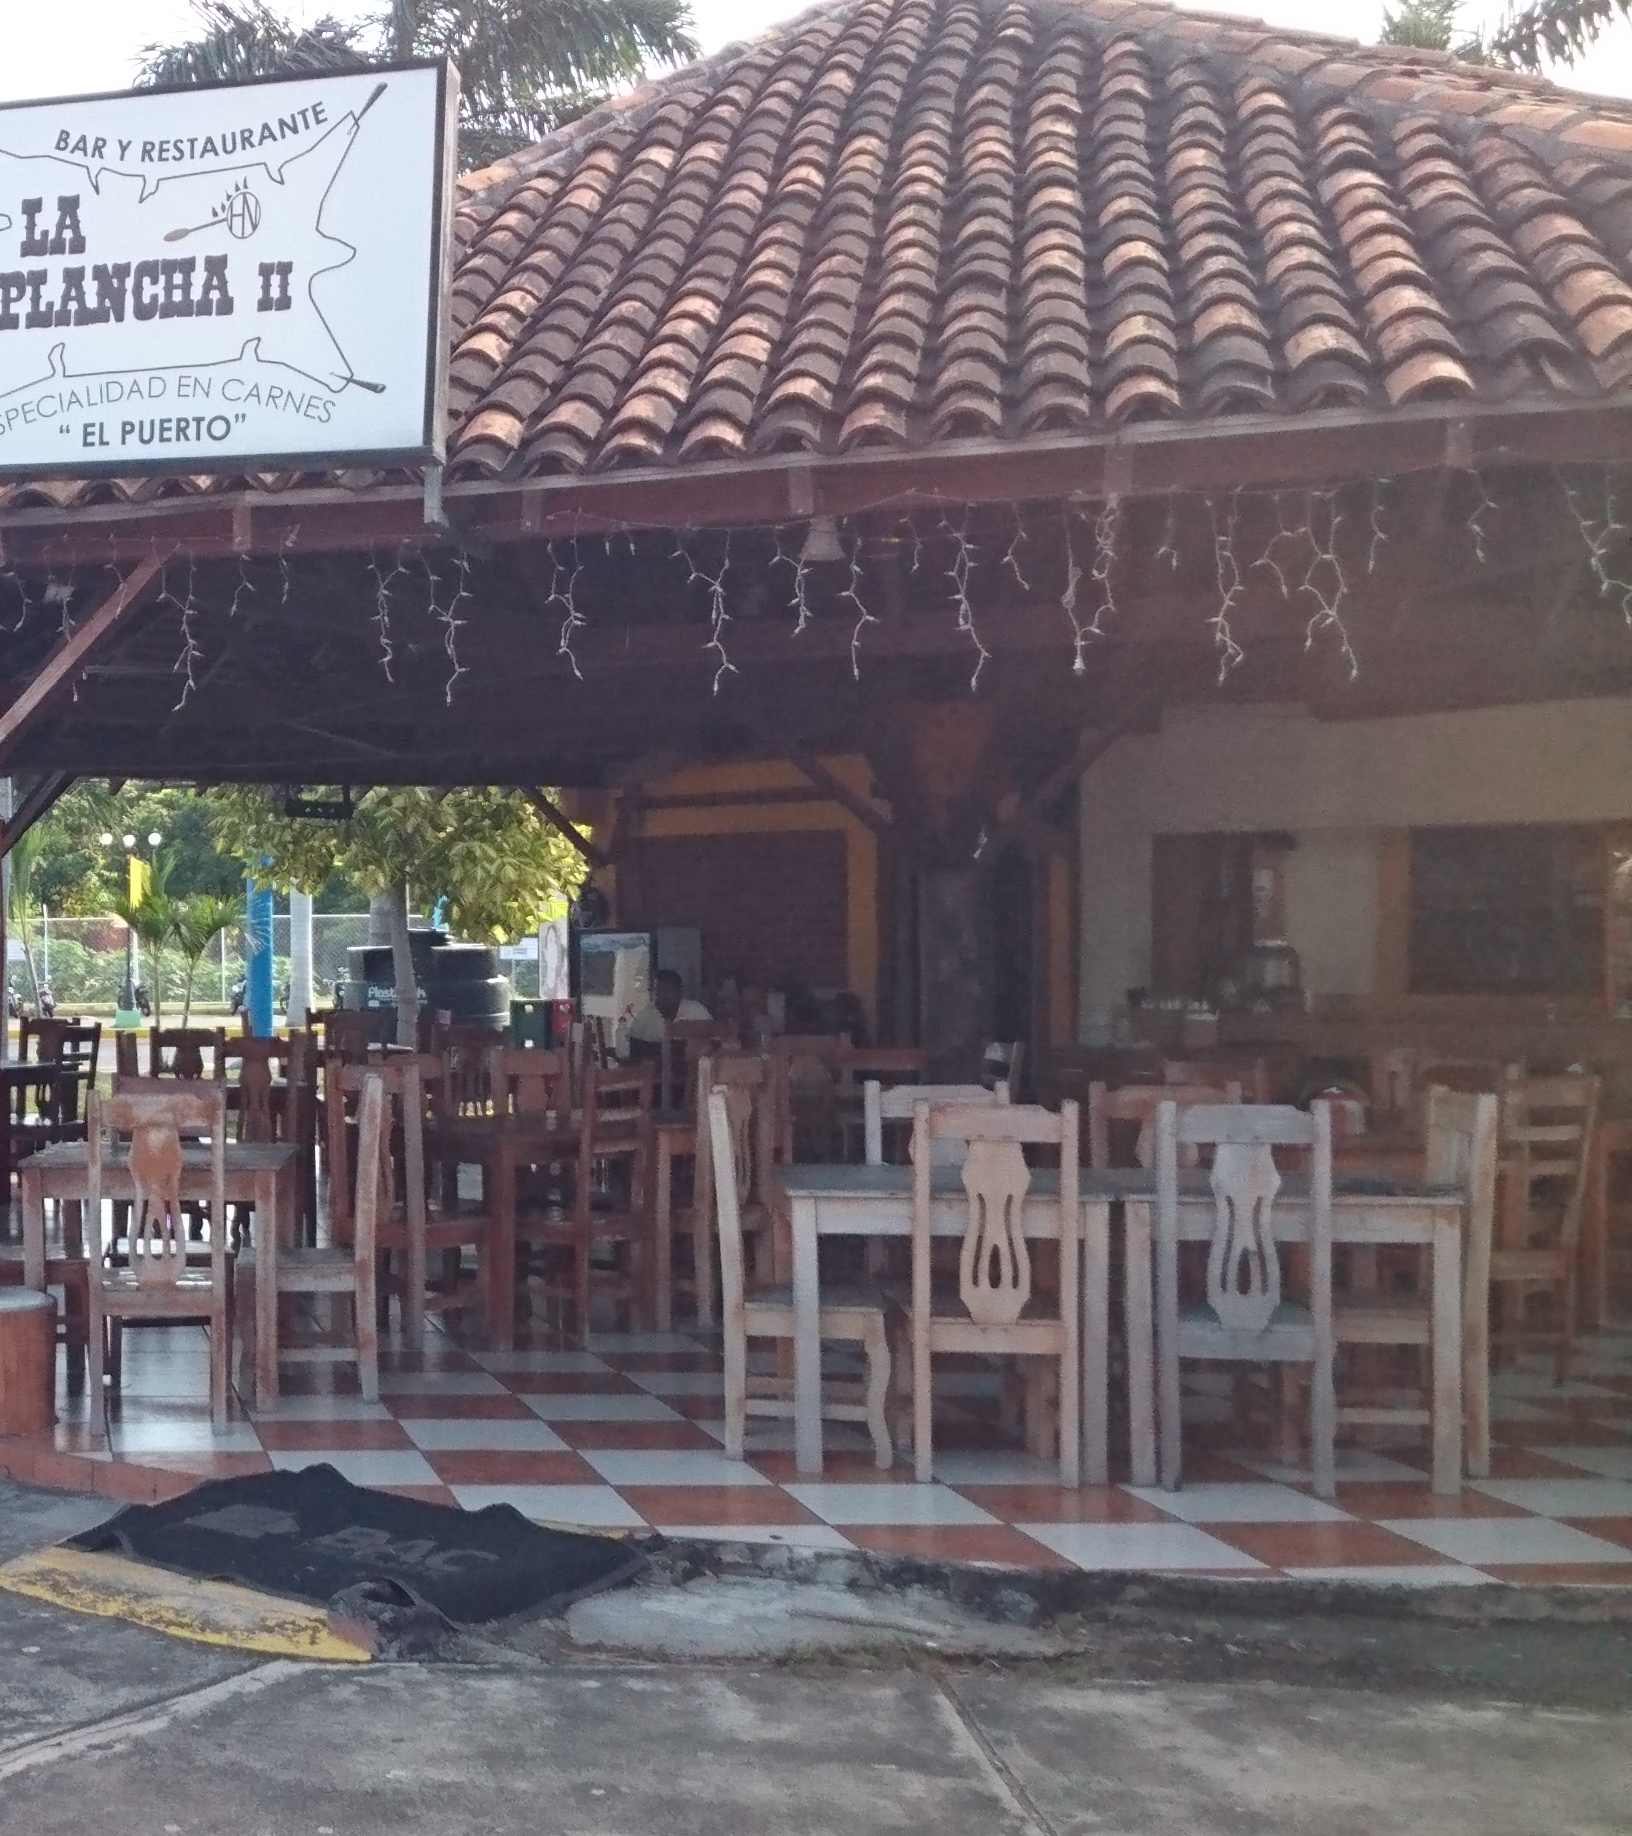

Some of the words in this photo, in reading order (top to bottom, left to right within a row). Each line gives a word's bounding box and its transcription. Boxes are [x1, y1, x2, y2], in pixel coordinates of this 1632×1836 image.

[54, 129, 107, 160] BAR
[117, 139, 132, 162] Y
[141, 101, 328, 162] RESTAURANTE
[20, 194, 87, 257] LA
[257, 261, 294, 312] II
[177, 375, 211, 398] EN
[222, 379, 336, 423] CARNES
